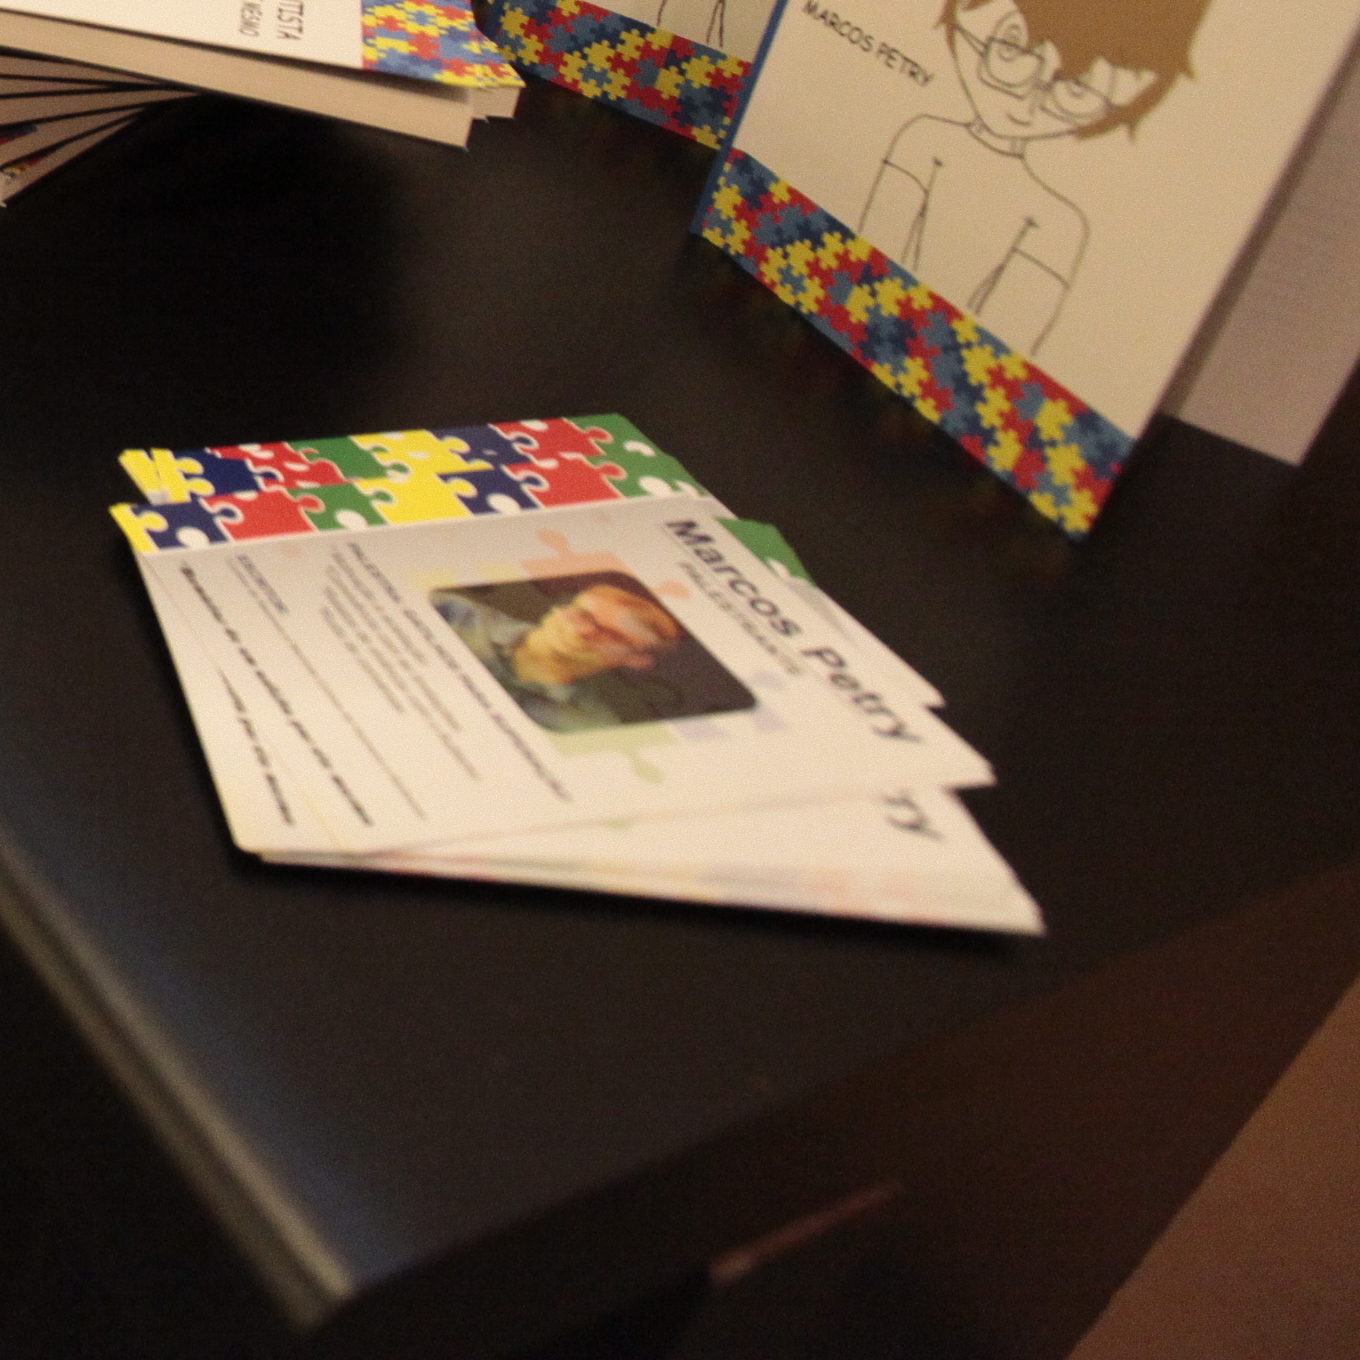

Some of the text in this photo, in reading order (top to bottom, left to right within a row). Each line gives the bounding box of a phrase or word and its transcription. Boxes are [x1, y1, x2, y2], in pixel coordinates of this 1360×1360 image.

[876, 41, 936, 87] PETRY
[665, 518, 925, 745] Marcos Petry
